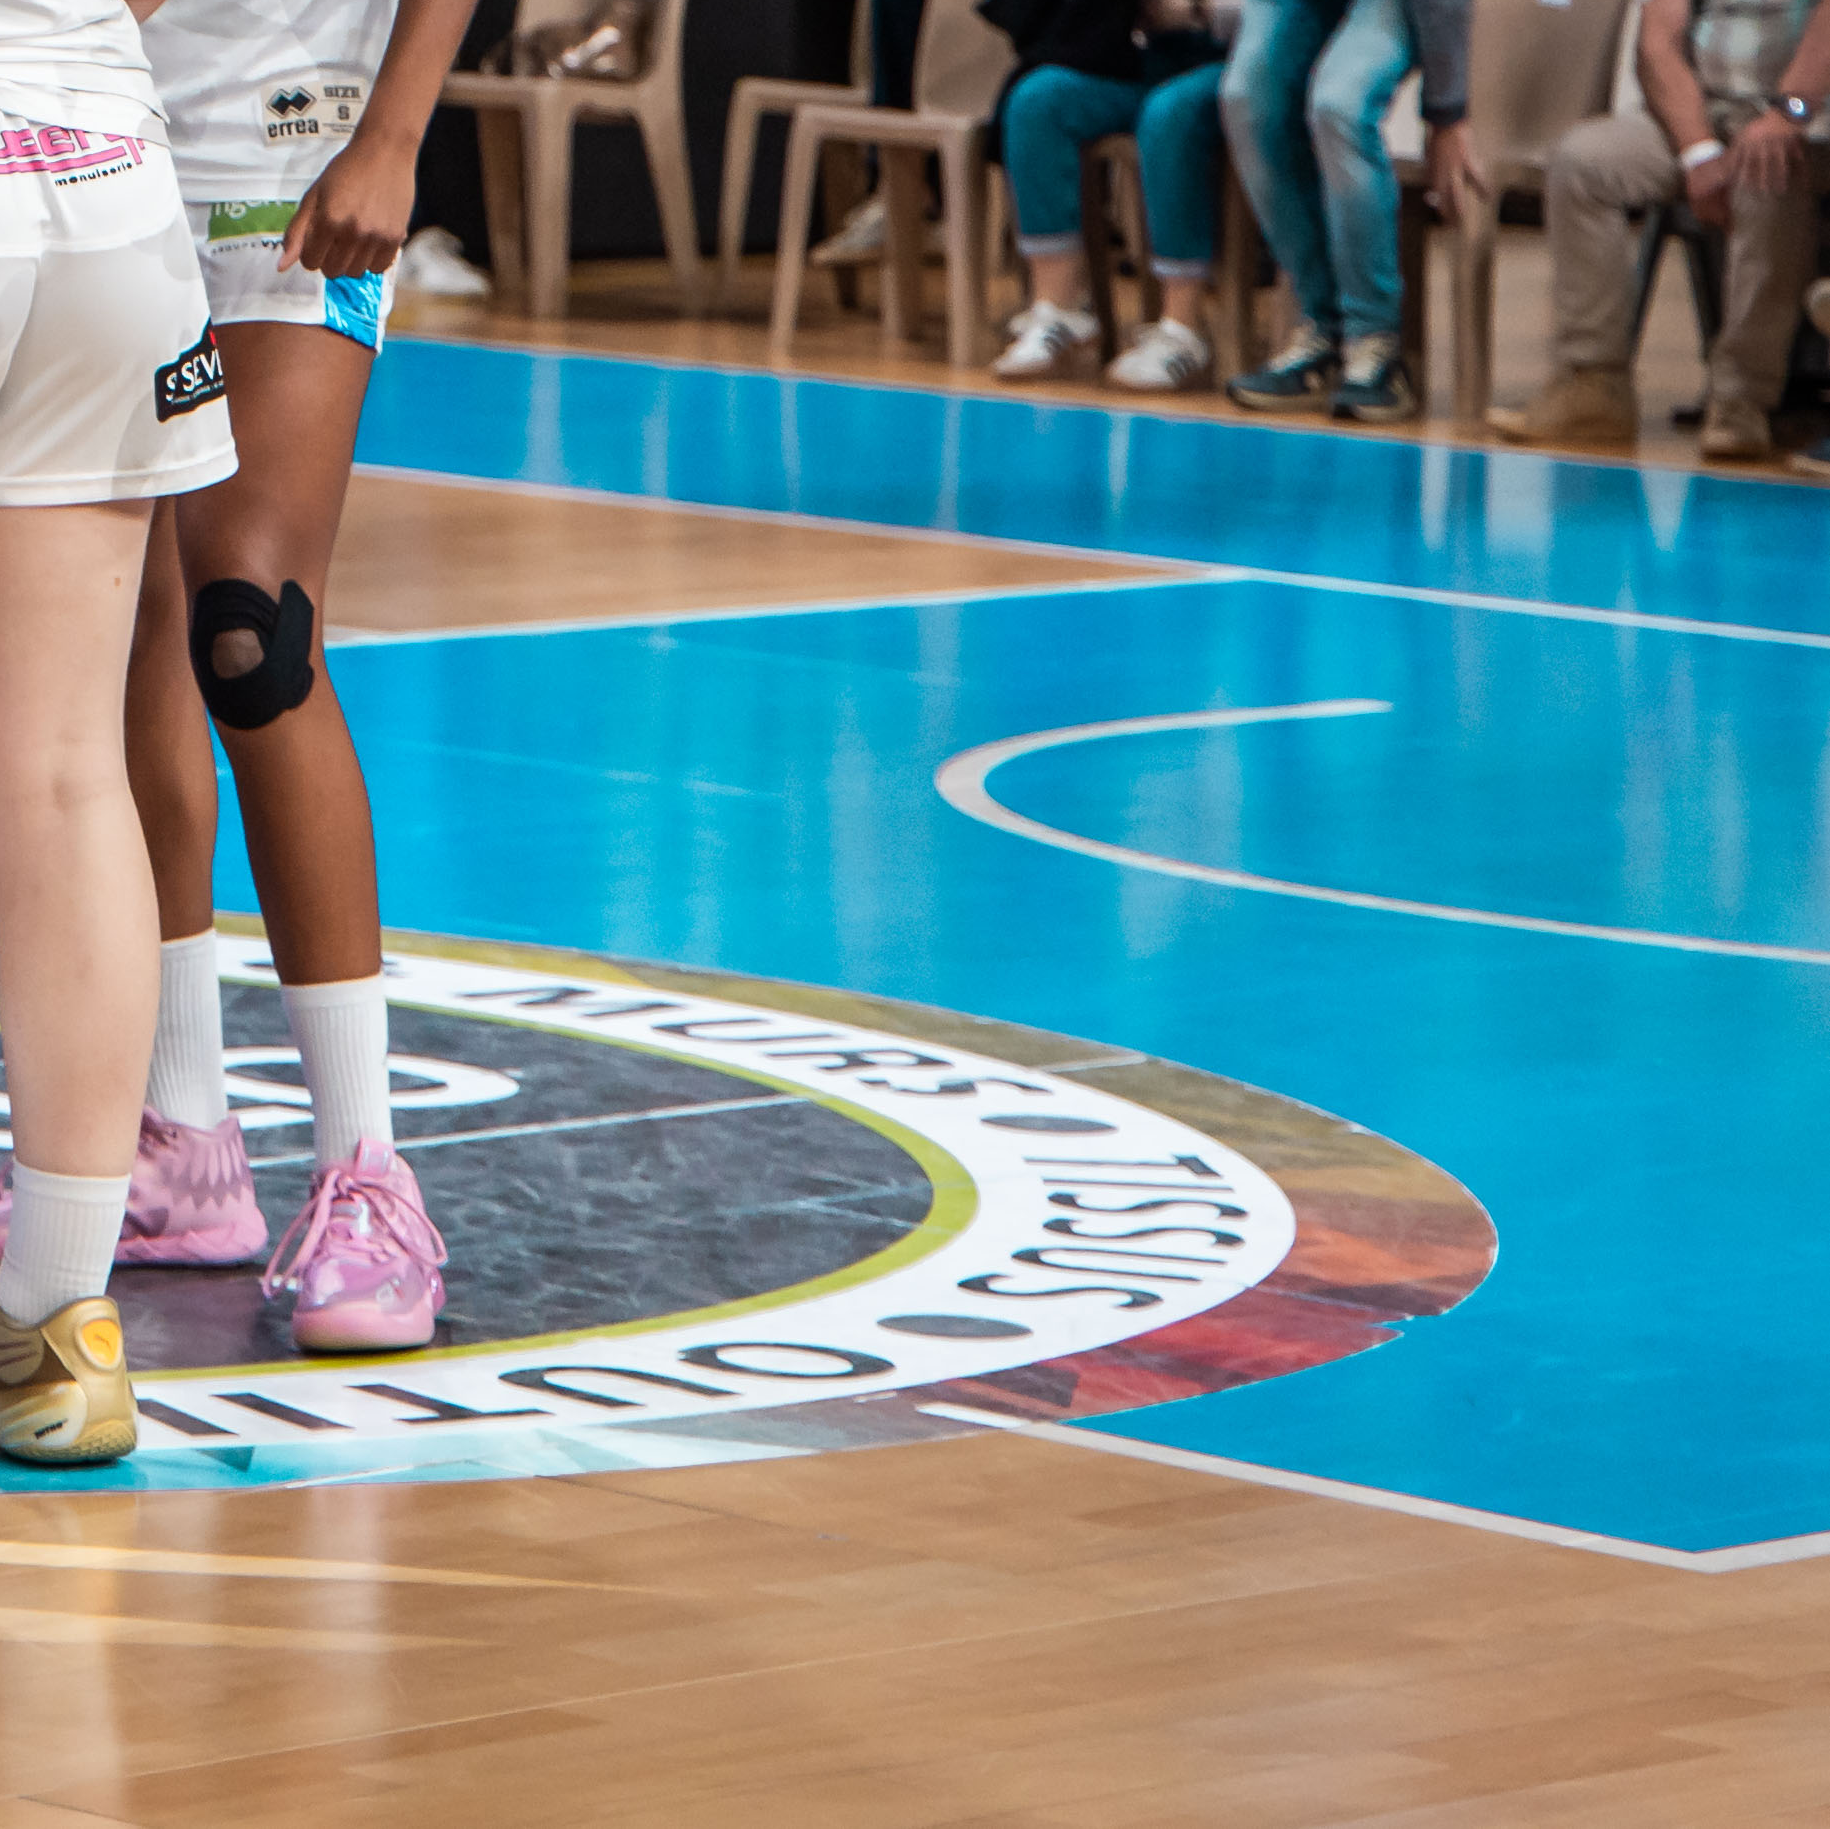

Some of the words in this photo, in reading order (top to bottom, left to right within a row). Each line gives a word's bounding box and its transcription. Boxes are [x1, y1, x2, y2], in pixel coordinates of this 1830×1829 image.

[323, 84, 360, 99] SIZE
[337, 103, 350, 121] S
[267, 118, 320, 139] errea
[54, 160, 133, 187] menuiserie
[458, 984, 1053, 1097] MURS
[957, 1153, 1249, 1309] TISSUS
